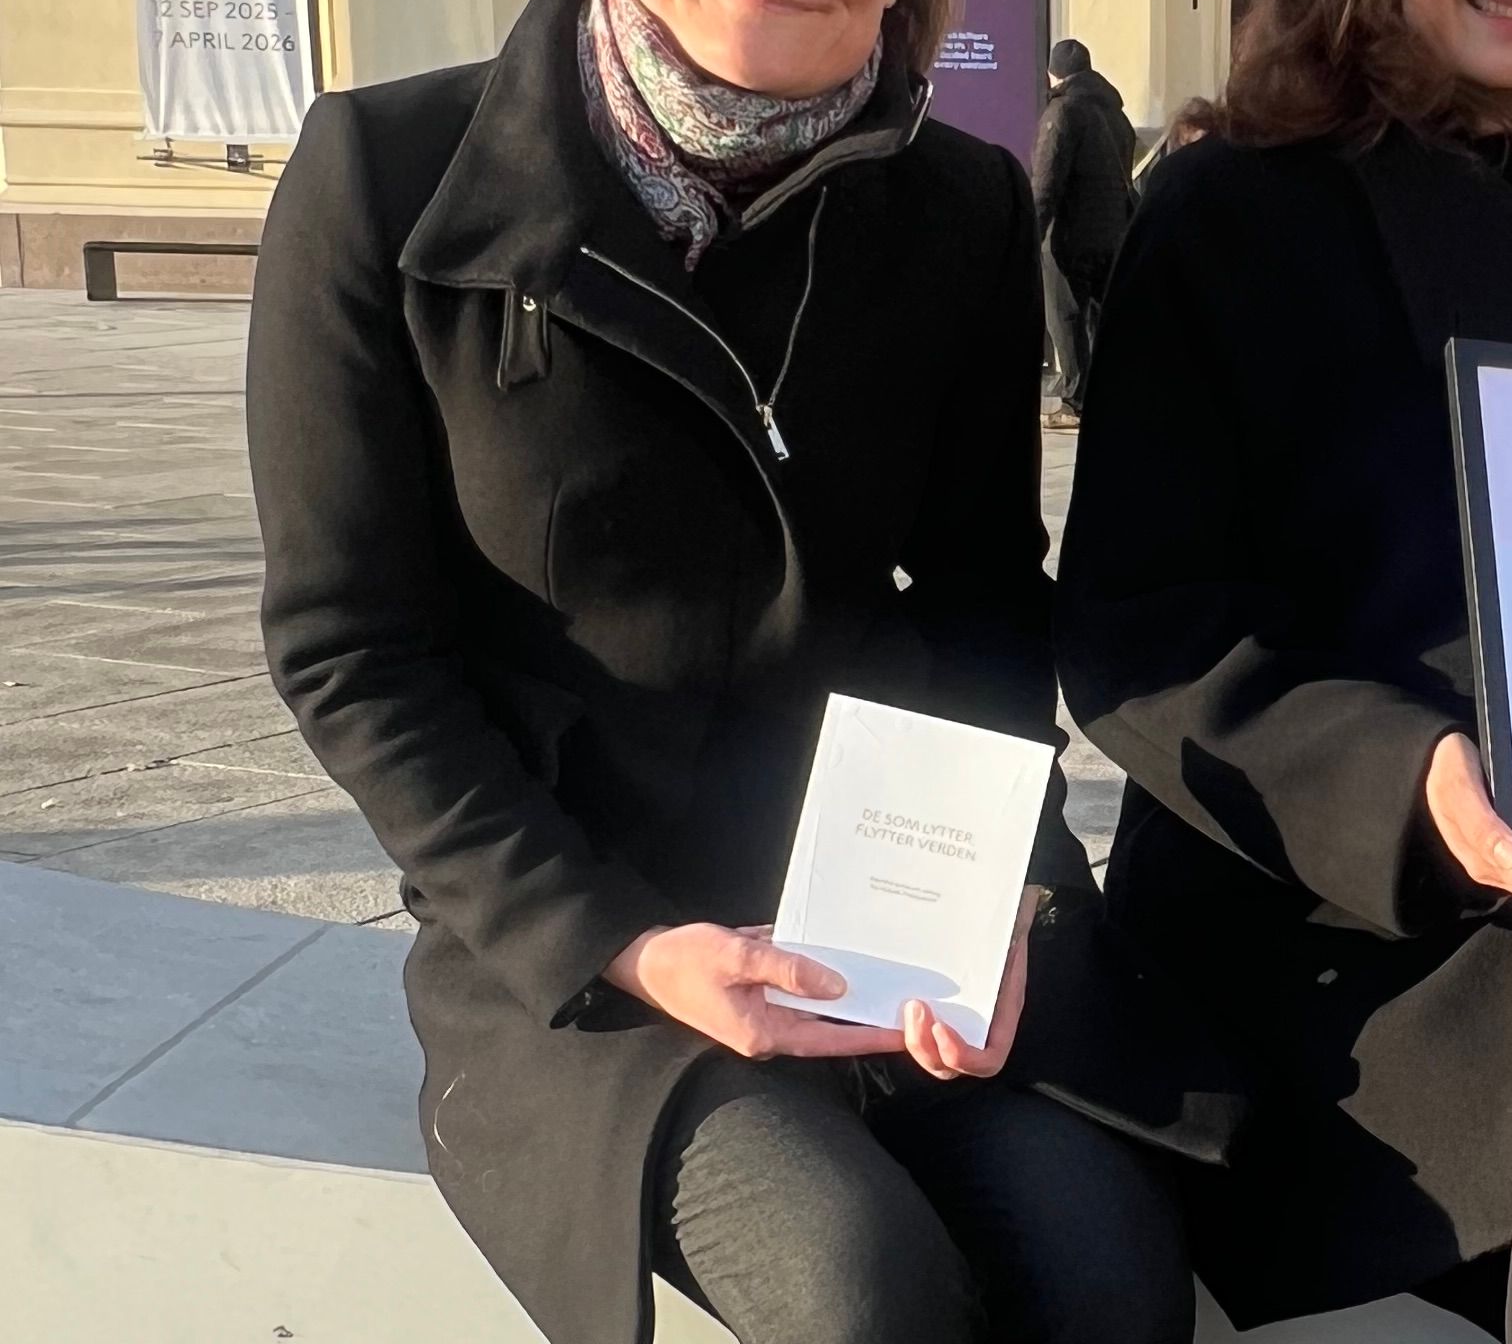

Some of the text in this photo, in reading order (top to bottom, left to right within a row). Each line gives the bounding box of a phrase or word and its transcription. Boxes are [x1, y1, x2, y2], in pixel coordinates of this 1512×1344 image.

[180, 0, 219, 19] SEP
[225, 1, 279, 20] 2025
[170, 31, 236, 50] APRIL
[242, 32, 296, 52] 2026
[861, 808, 882, 823] DE
[884, 813, 920, 832] SOM
[855, 823, 977, 862] FLYTTER VERDEN
